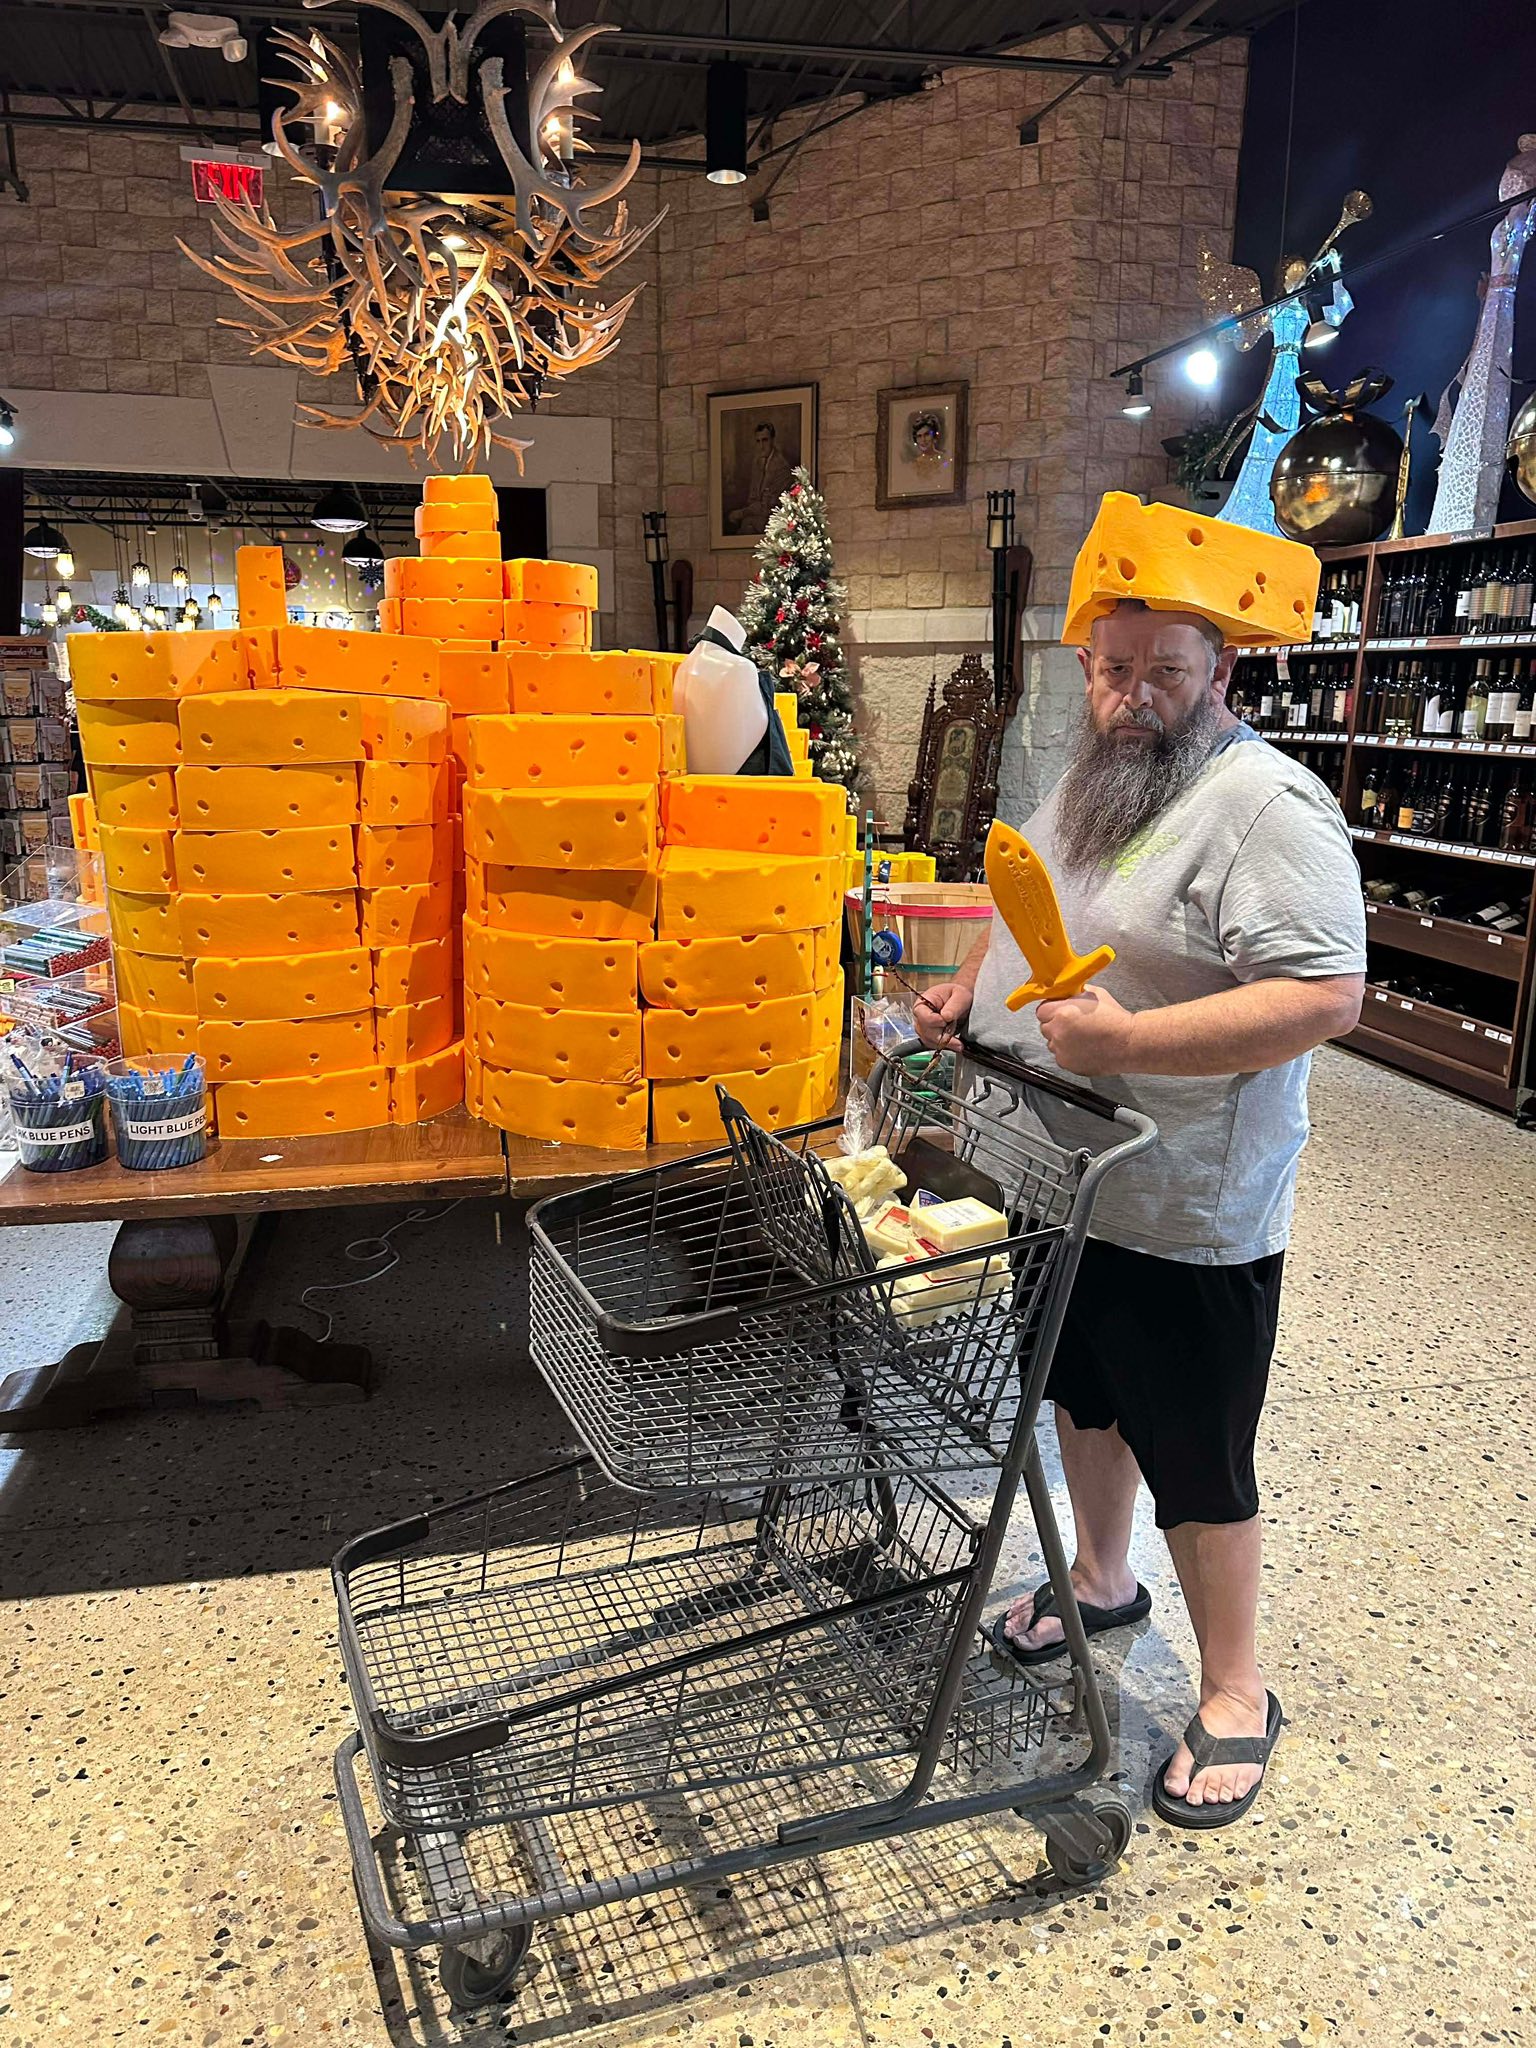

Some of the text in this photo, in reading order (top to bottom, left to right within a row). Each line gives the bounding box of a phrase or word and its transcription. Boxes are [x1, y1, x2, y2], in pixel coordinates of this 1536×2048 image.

[207, 163, 251, 200] EXIT
[29, 1131, 57, 1141] BLUE
[60, 1125, 91, 1140] PENS
[130, 1124, 164, 1135] LIGHT
[166, 1120, 193, 1134] BLUE
